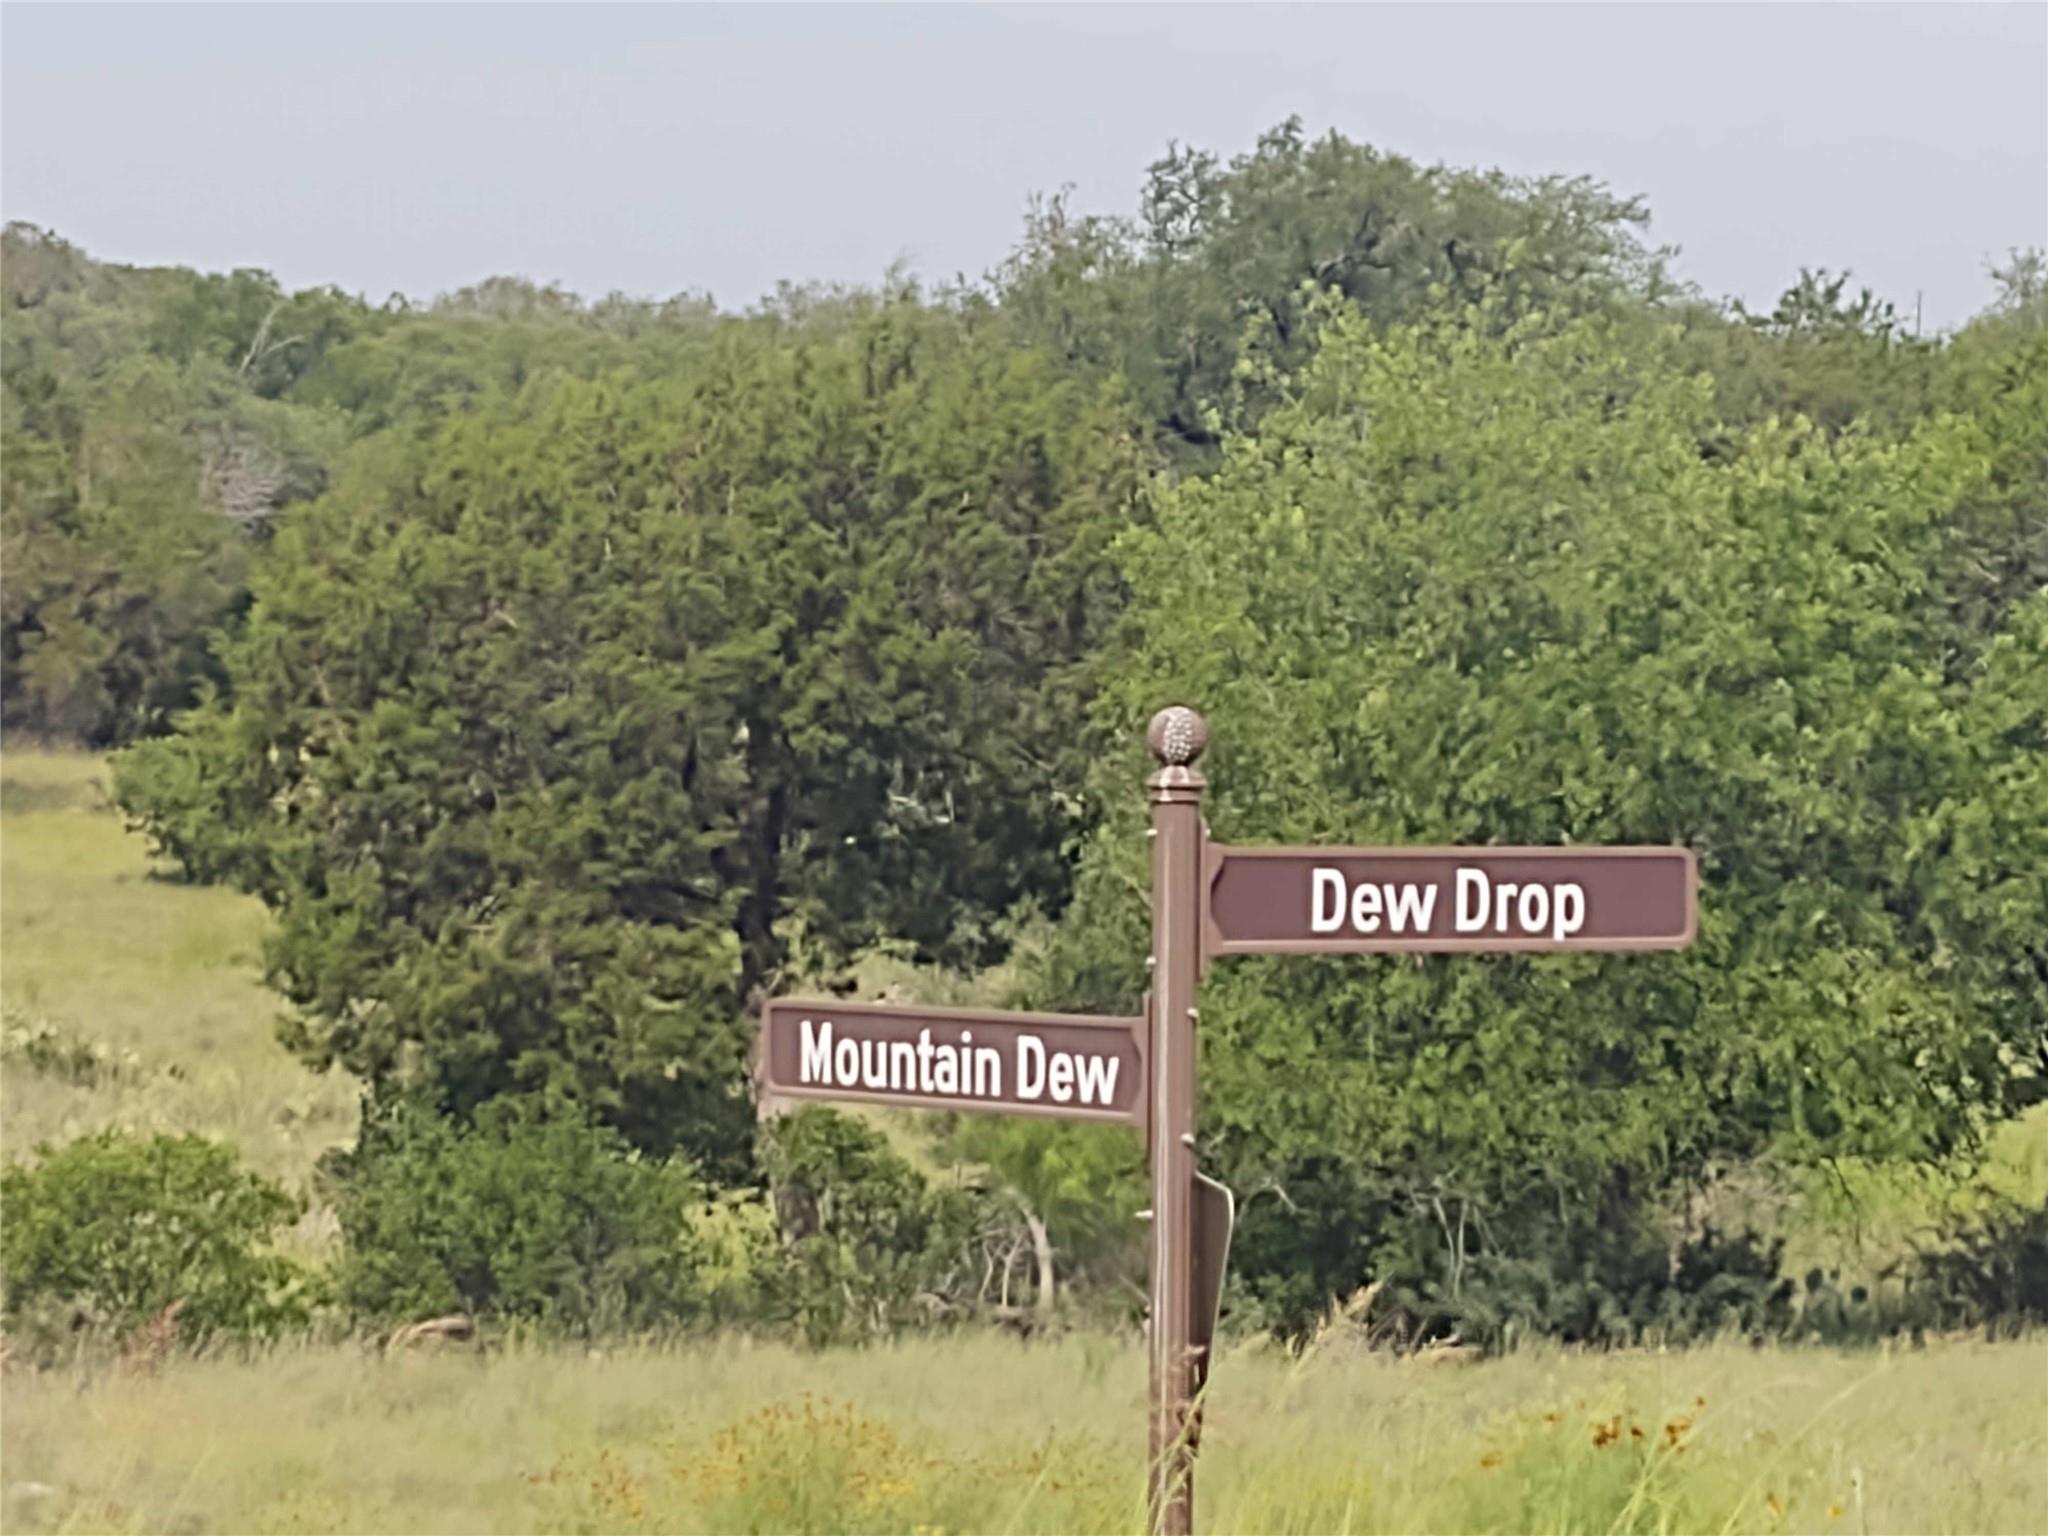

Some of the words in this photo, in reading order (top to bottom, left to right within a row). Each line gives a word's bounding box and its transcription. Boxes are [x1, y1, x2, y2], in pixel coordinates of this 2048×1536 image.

[1310, 867, 1438, 933] Dew
[1455, 867, 1585, 942] Drop
[798, 1019, 1002, 1098] Mountain
[1015, 1034, 1120, 1106] Dew
